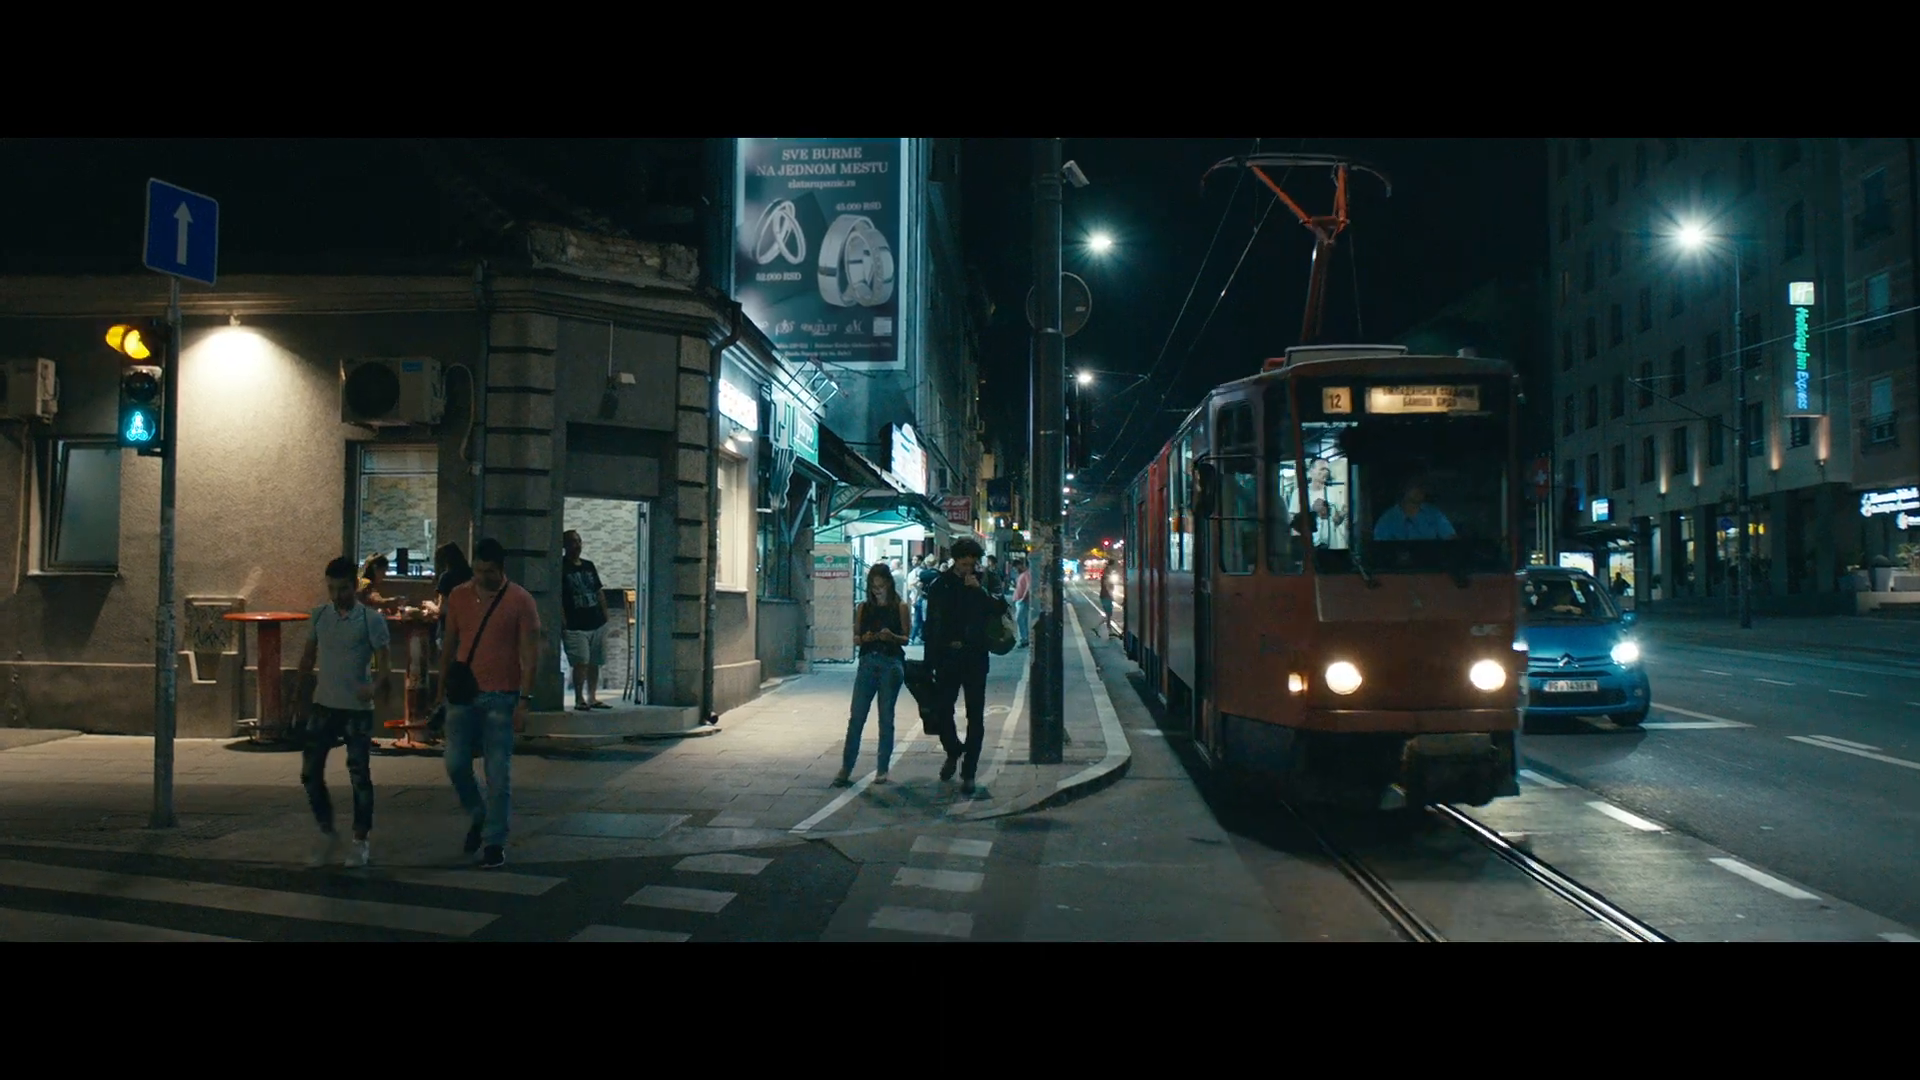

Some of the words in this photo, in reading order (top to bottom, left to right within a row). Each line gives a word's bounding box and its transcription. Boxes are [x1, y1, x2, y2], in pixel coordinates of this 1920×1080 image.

[782, 148, 808, 161] SVE
[812, 147, 862, 160] BURME
[756, 165, 776, 177] NA
[777, 163, 837, 176] JEDNOM
[840, 162, 888, 175] MESTU
[863, 201, 882, 211] RSD
[783, 272, 802, 281] RSD
[1793, 307, 1810, 350] Holiday
[1796, 351, 1810, 370] Inn
[1794, 371, 1809, 409] Express
[1330, 394, 1342, 409] 12
